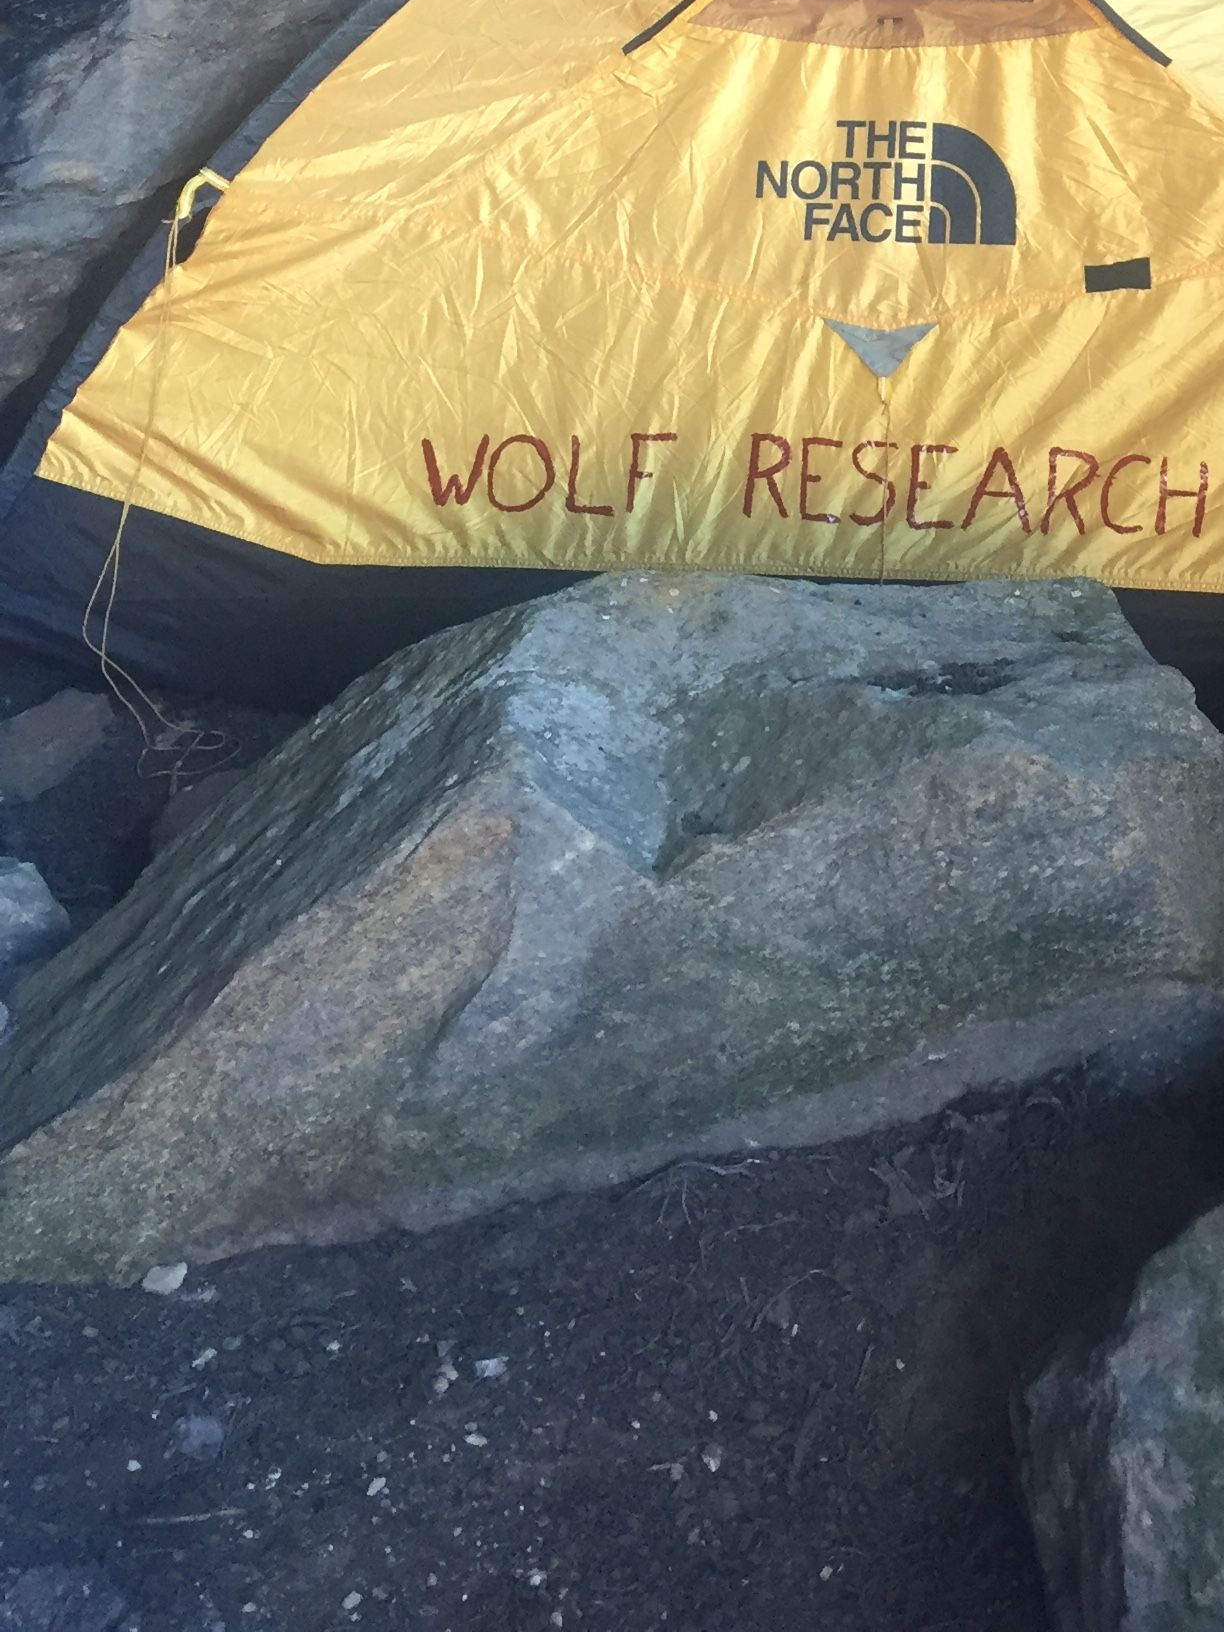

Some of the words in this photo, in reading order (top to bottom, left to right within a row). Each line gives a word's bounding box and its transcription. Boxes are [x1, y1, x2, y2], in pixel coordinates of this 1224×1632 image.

[836, 120, 927, 160] THE
[755, 160, 926, 202] NORTH
[803, 203, 924, 244] FACE
[421, 432, 678, 513] WOLF
[742, 432, 1210, 538] RESEARCH
